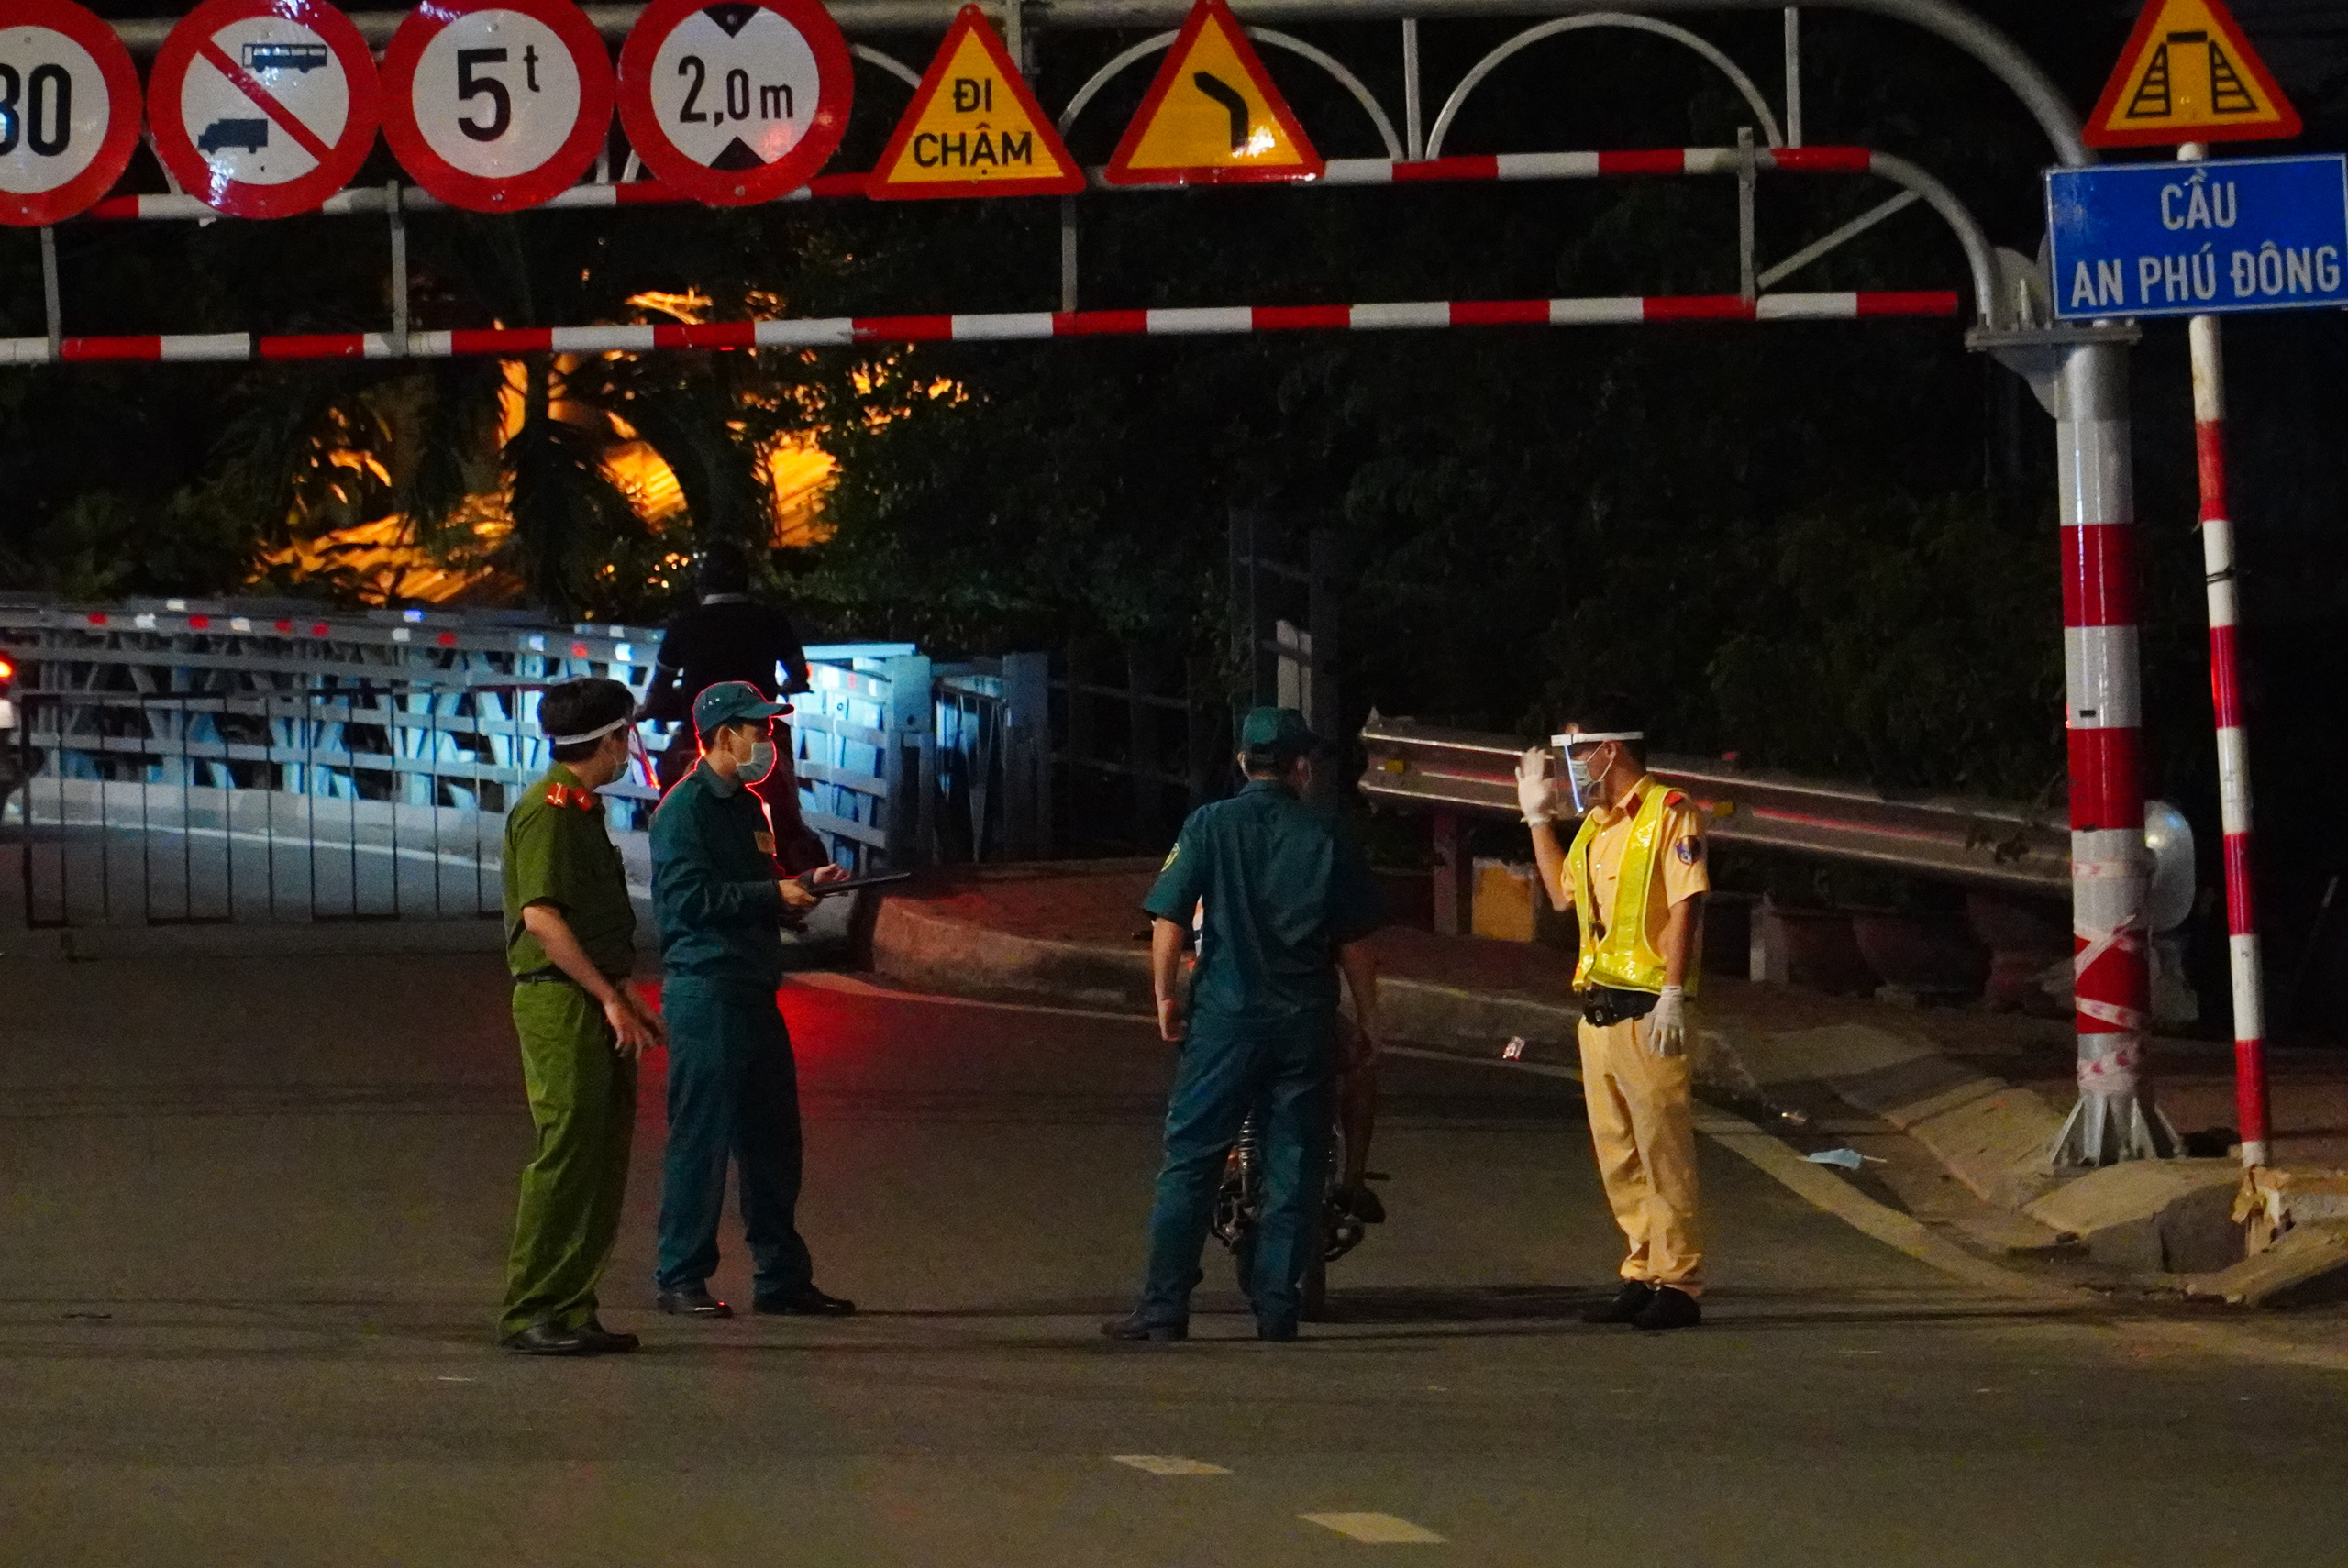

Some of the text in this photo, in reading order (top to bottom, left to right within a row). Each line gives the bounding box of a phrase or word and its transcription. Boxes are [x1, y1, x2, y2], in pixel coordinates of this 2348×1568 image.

[953, 78, 991, 113] ĐI
[914, 122, 1032, 175] CHẬM
[2161, 167, 2236, 230] CẦU
[2071, 240, 2341, 308] AN PHÚ ĐÔNG
